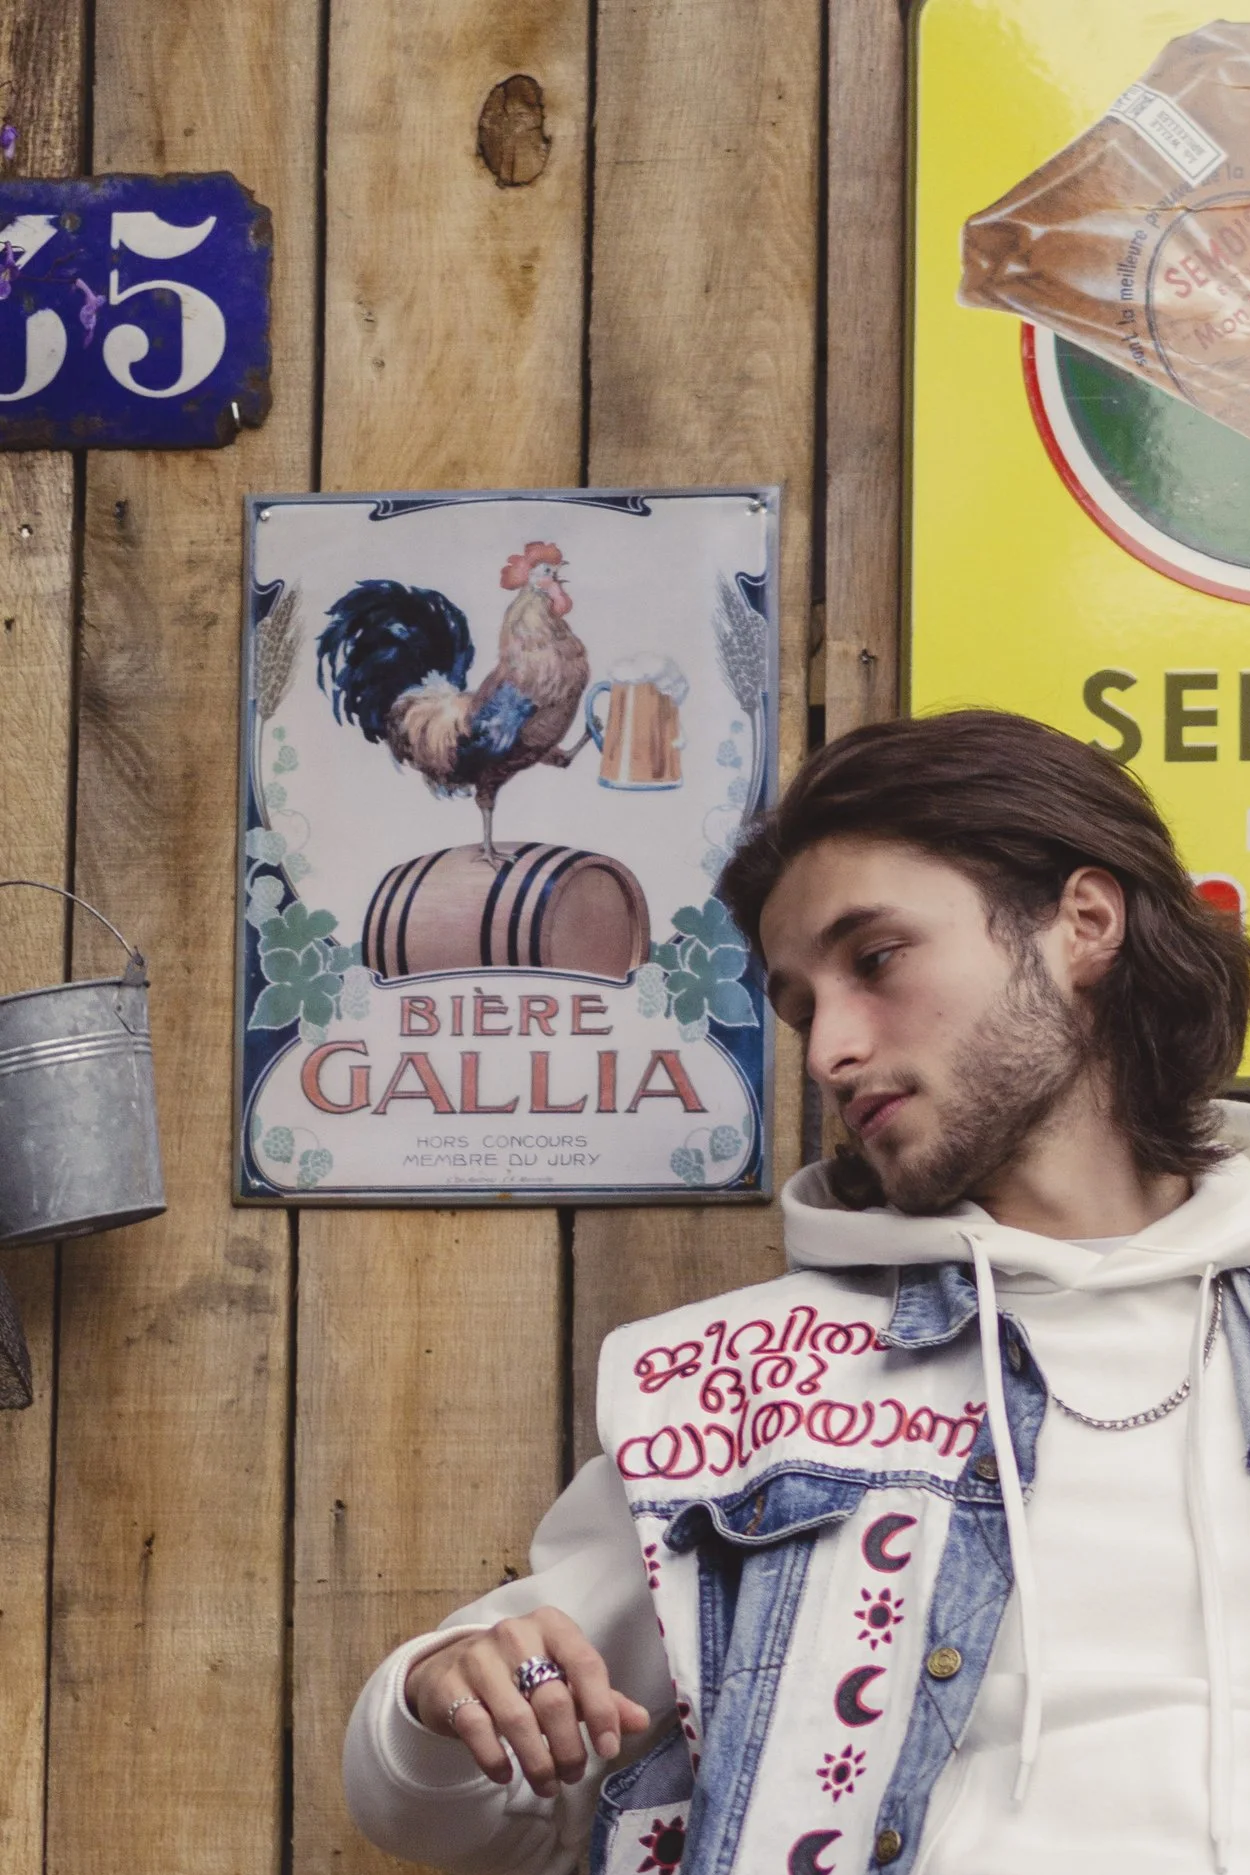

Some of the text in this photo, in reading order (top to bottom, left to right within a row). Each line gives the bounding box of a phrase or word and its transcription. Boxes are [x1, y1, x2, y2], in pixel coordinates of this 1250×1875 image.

[1226, 162, 1244, 181] la
[1115, 229, 1148, 301] meilleure
[1116, 309, 1136, 326] la
[400, 986, 613, 1038] BIÈRE
[299, 1040, 710, 1117] GALLIA
[416, 1135, 588, 1149] HORS CONCOURS
[402, 1153, 601, 1167] MEMBRE DU JURY
